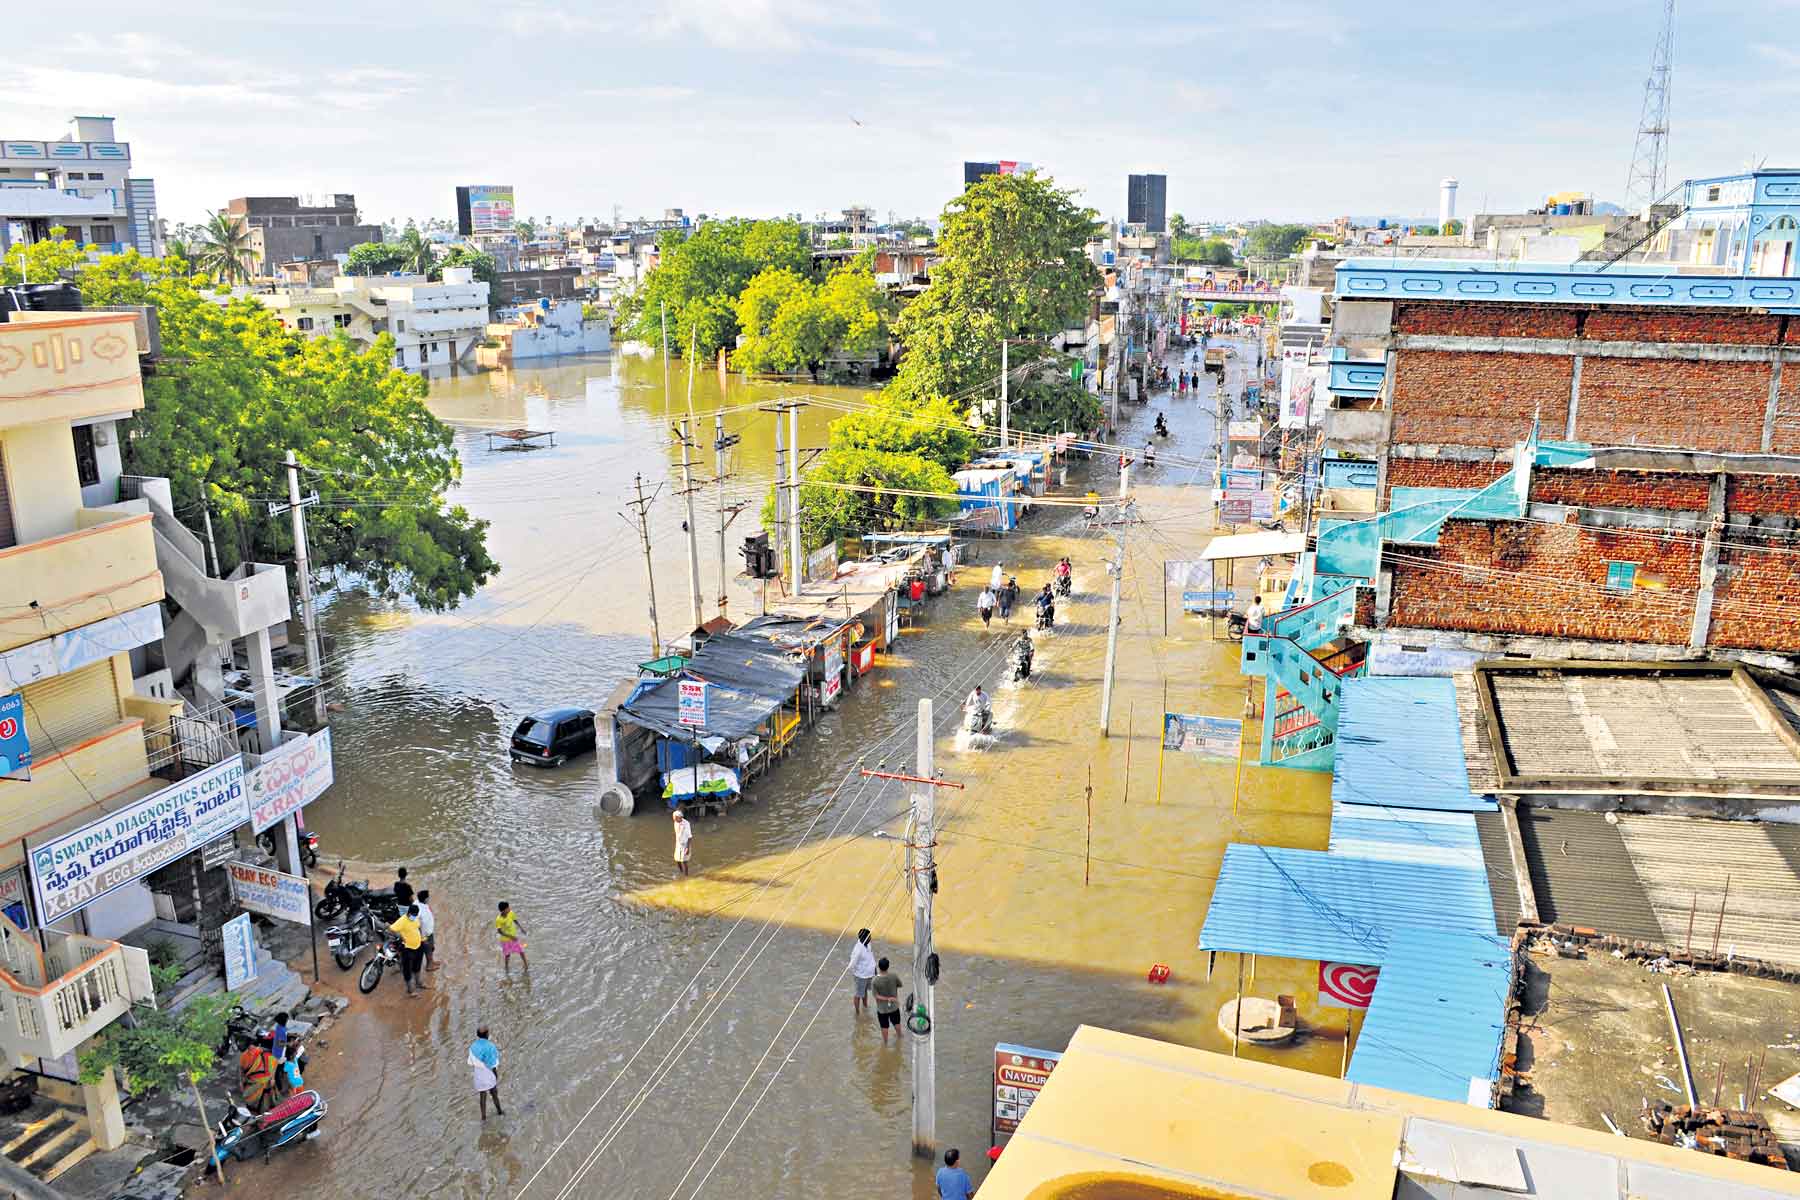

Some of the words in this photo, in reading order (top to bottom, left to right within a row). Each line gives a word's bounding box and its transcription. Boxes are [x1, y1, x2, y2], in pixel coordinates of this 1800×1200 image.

[55, 826, 113, 865] SWAPNA
[116, 787, 198, 837] DIAGNOSTICS
[200, 766, 243, 795] CENTER
[255, 783, 304, 825] X-RAY
[105, 864, 131, 888] ECG
